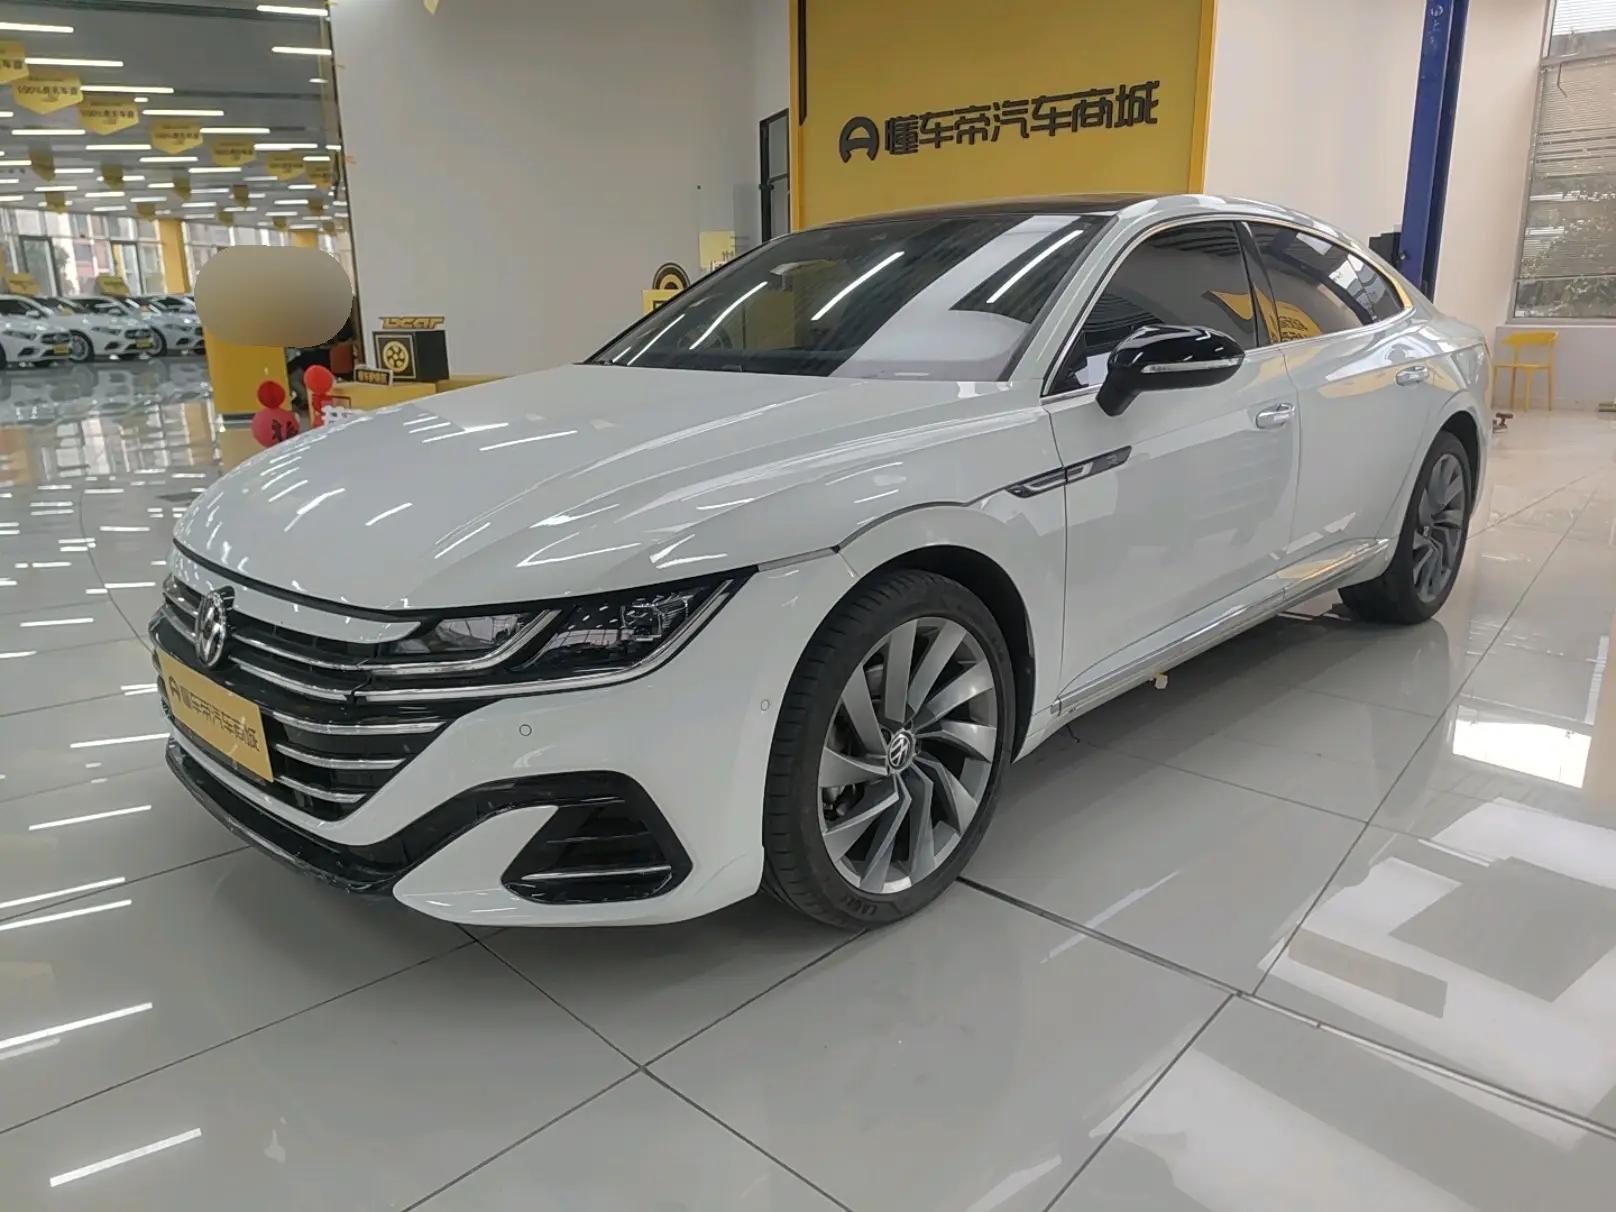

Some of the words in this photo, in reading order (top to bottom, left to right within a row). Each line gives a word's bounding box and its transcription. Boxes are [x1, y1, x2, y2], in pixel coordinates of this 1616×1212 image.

[885, 80, 1160, 155] 懂车帝汽车商城
